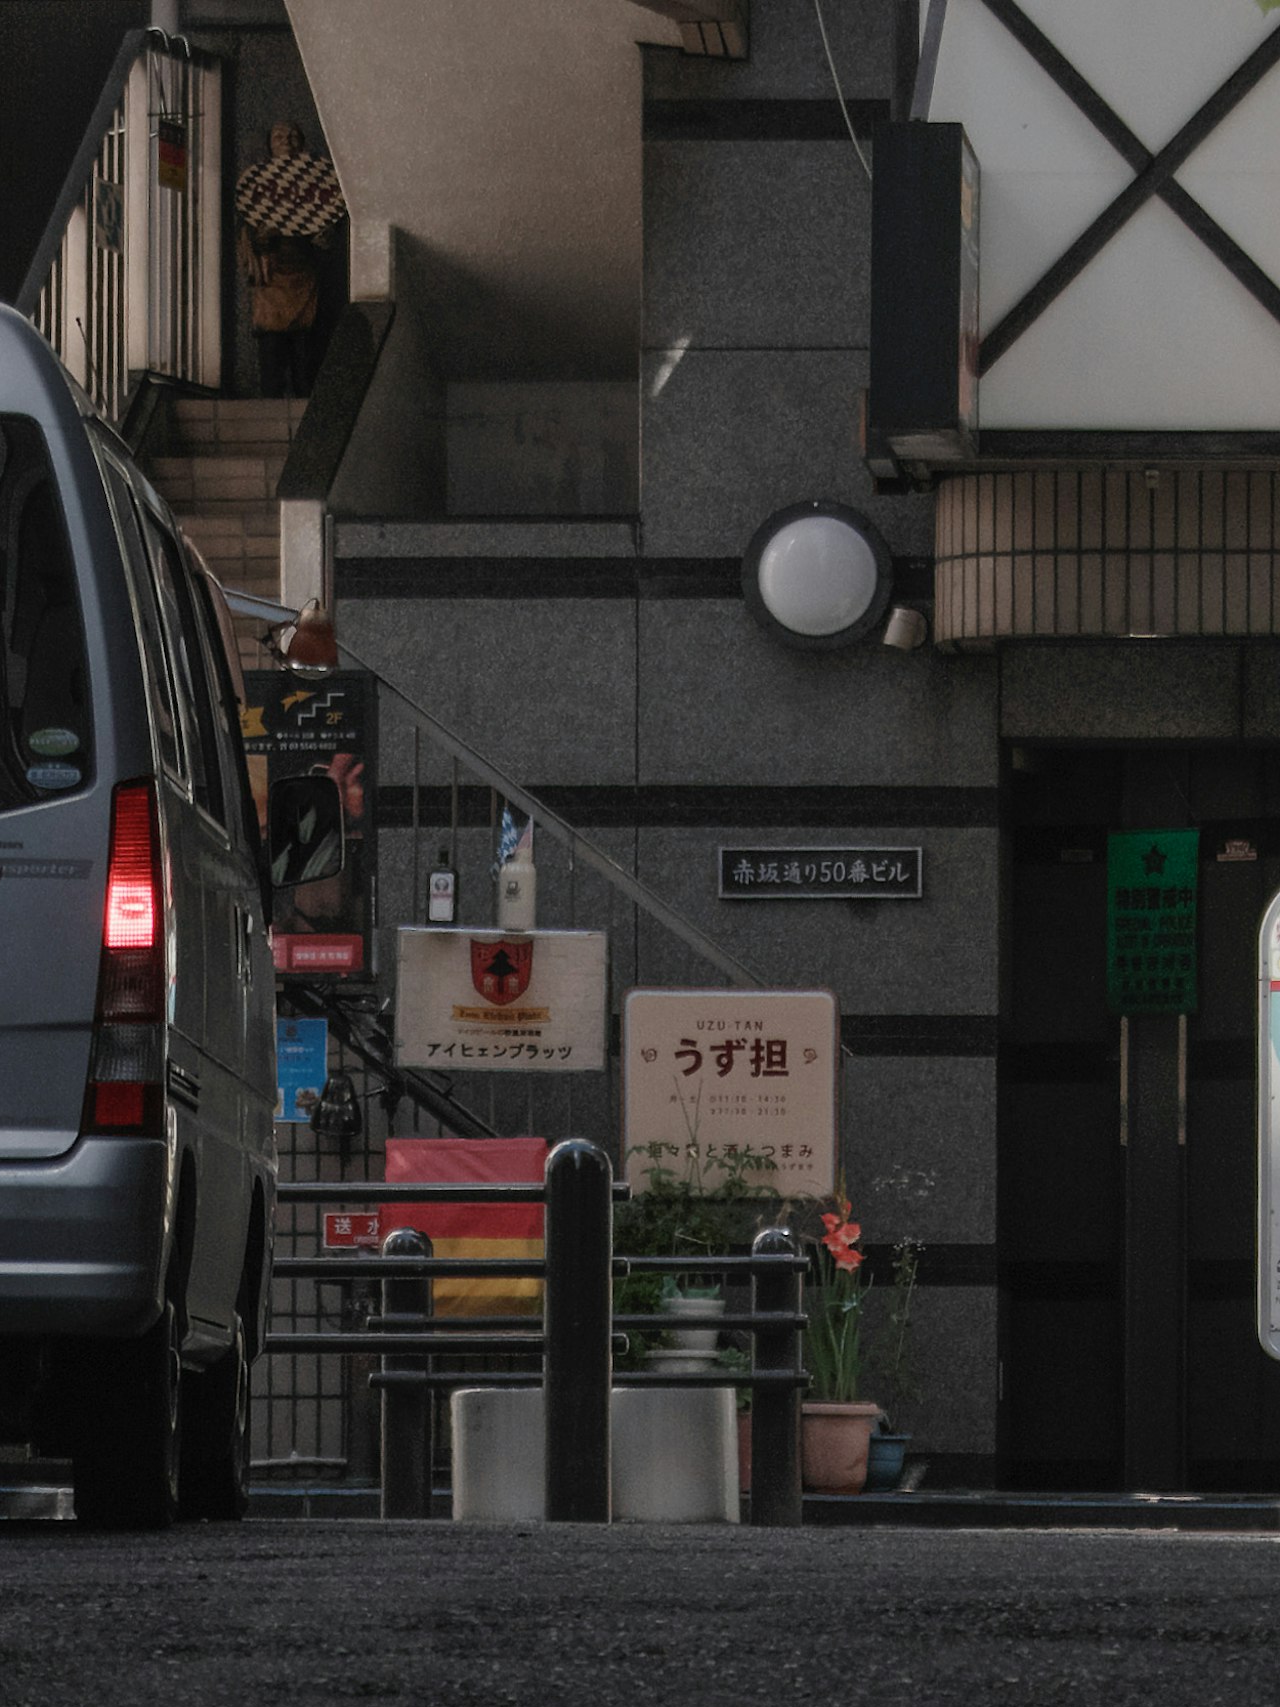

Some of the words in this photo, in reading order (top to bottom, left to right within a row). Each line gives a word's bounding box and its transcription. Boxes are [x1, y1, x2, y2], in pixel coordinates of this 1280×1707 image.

[326, 711, 344, 725] 2F
[733, 859, 910, 885] 赤坂通り50番ビル
[674, 1038, 790, 1078] うず担
